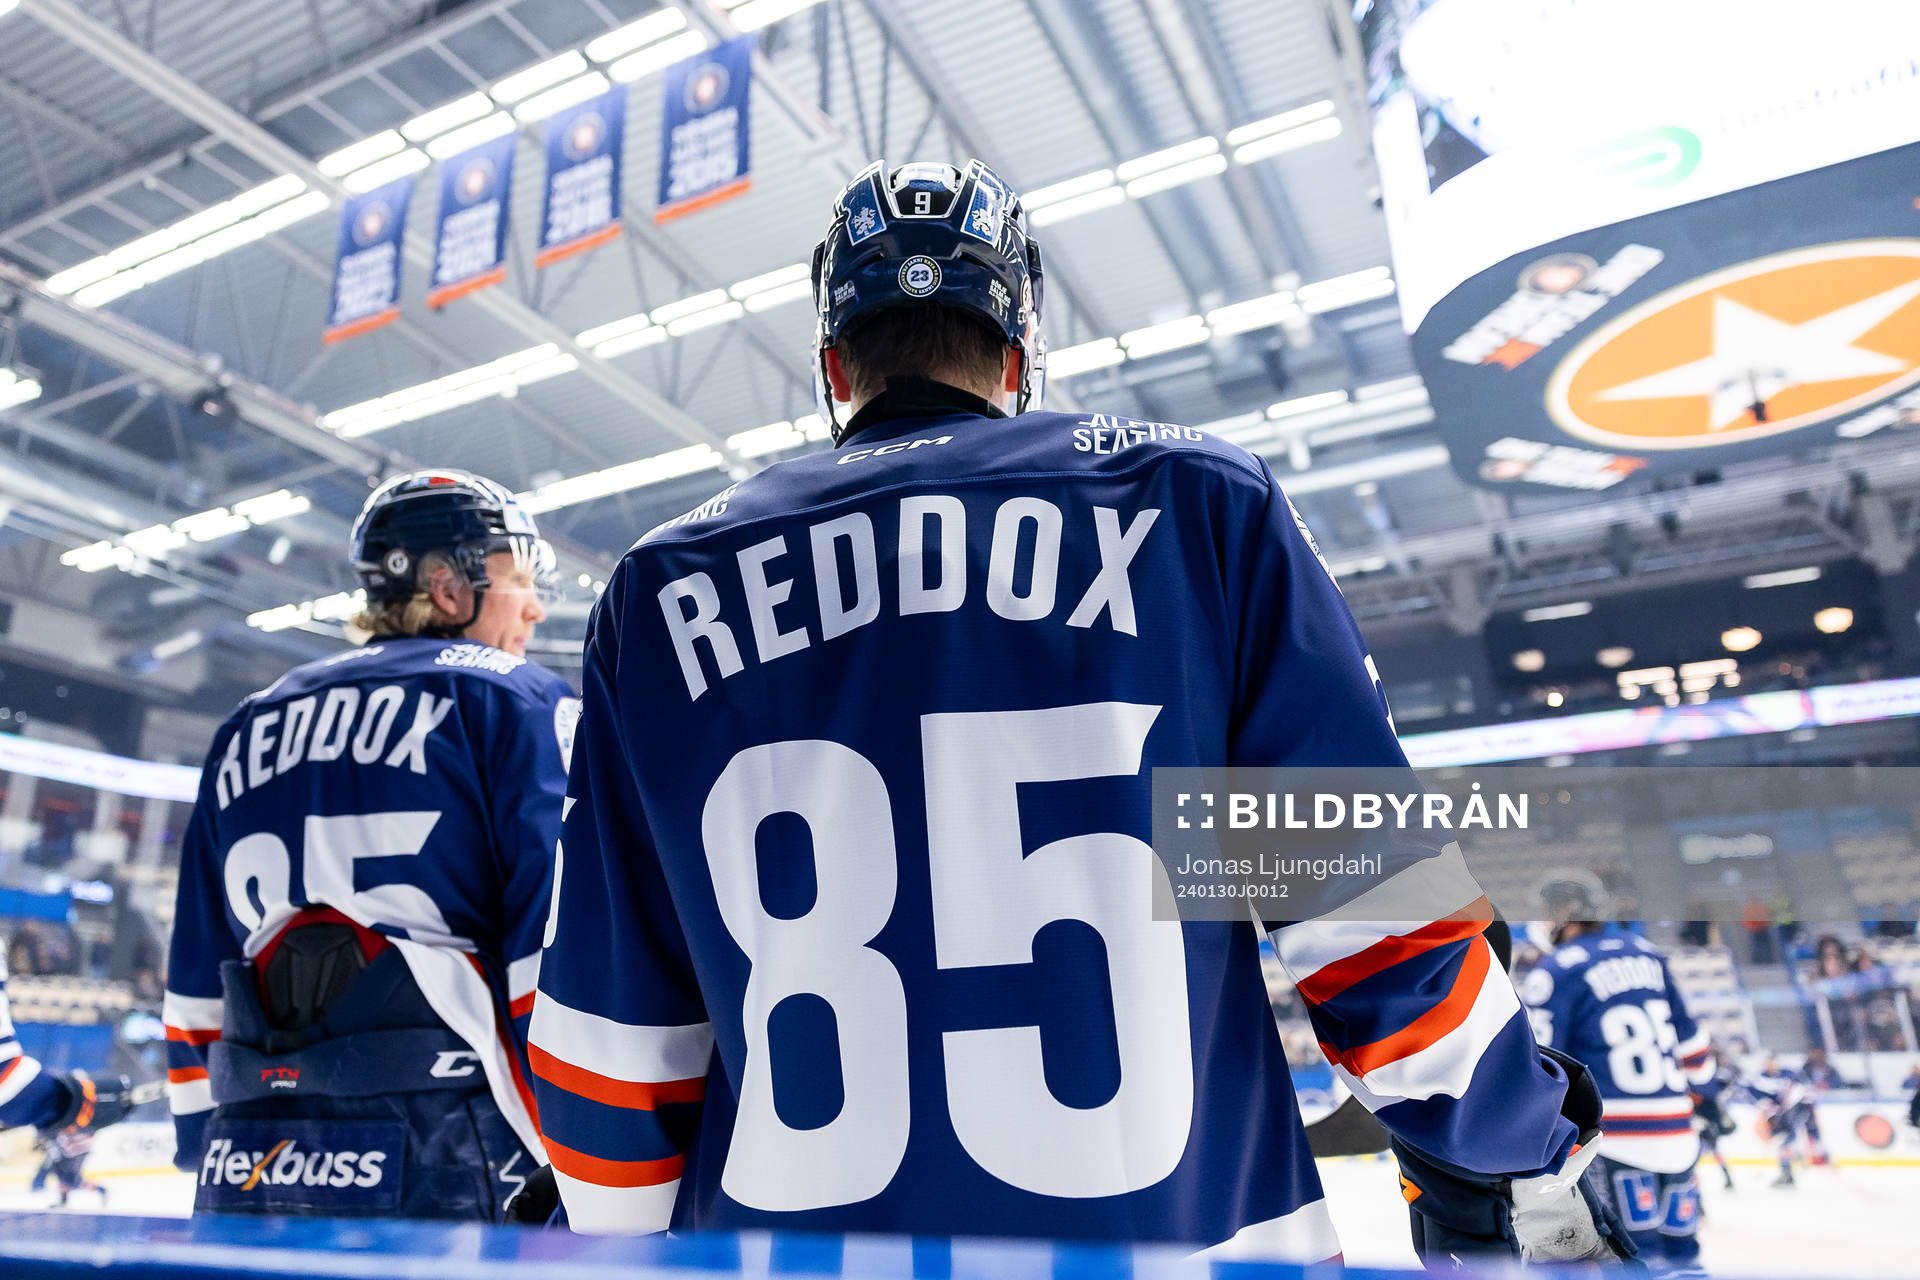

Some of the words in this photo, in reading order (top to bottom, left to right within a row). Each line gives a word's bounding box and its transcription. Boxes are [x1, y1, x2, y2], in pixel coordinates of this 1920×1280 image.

[915, 192, 931, 214] 9
[911, 270, 929, 281] 23
[836, 436, 953, 465] CCM
[1072, 423, 1203, 454] SEATING
[657, 495, 1161, 701] REDDOX
[702, 702, 1194, 1211] 85
[201, 1139, 387, 1191] Flexbuss
